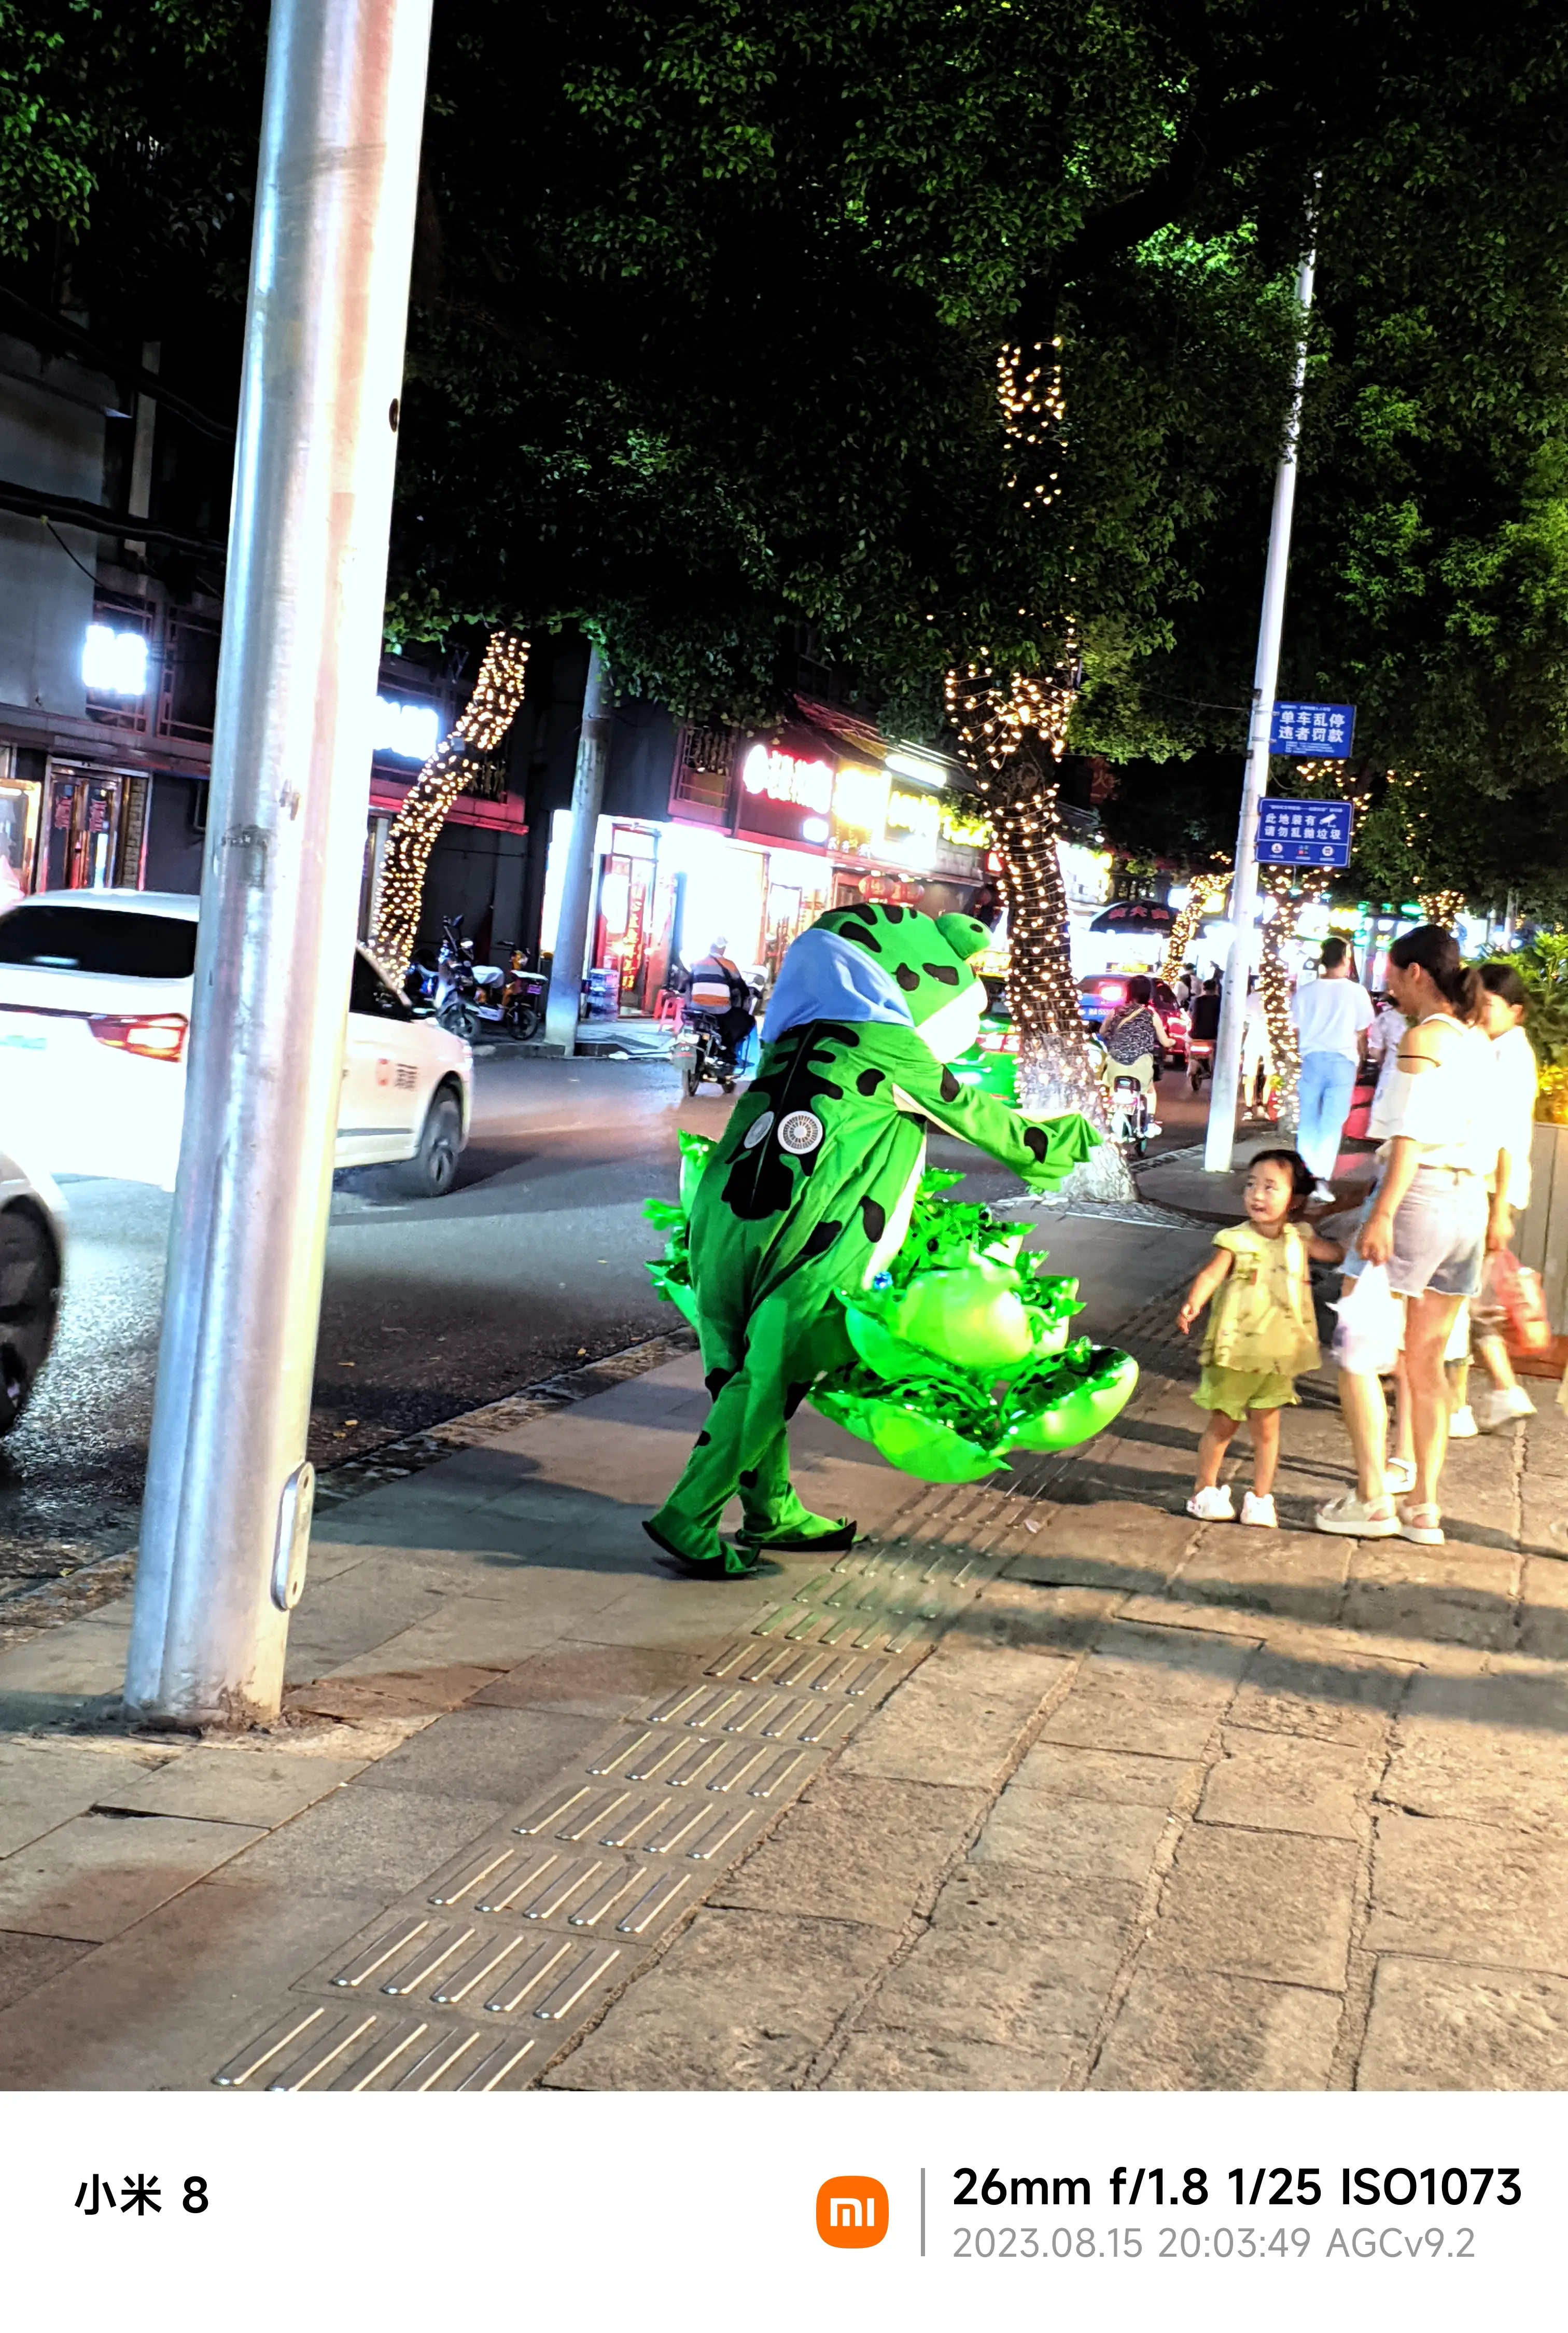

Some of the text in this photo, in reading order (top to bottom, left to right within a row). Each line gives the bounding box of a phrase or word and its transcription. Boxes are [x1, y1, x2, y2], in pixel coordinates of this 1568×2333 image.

[1279, 711, 1346, 728] 单车乱停
[1278, 725, 1345, 743] 违者罚款
[1265, 813, 1316, 826] 此地装有
